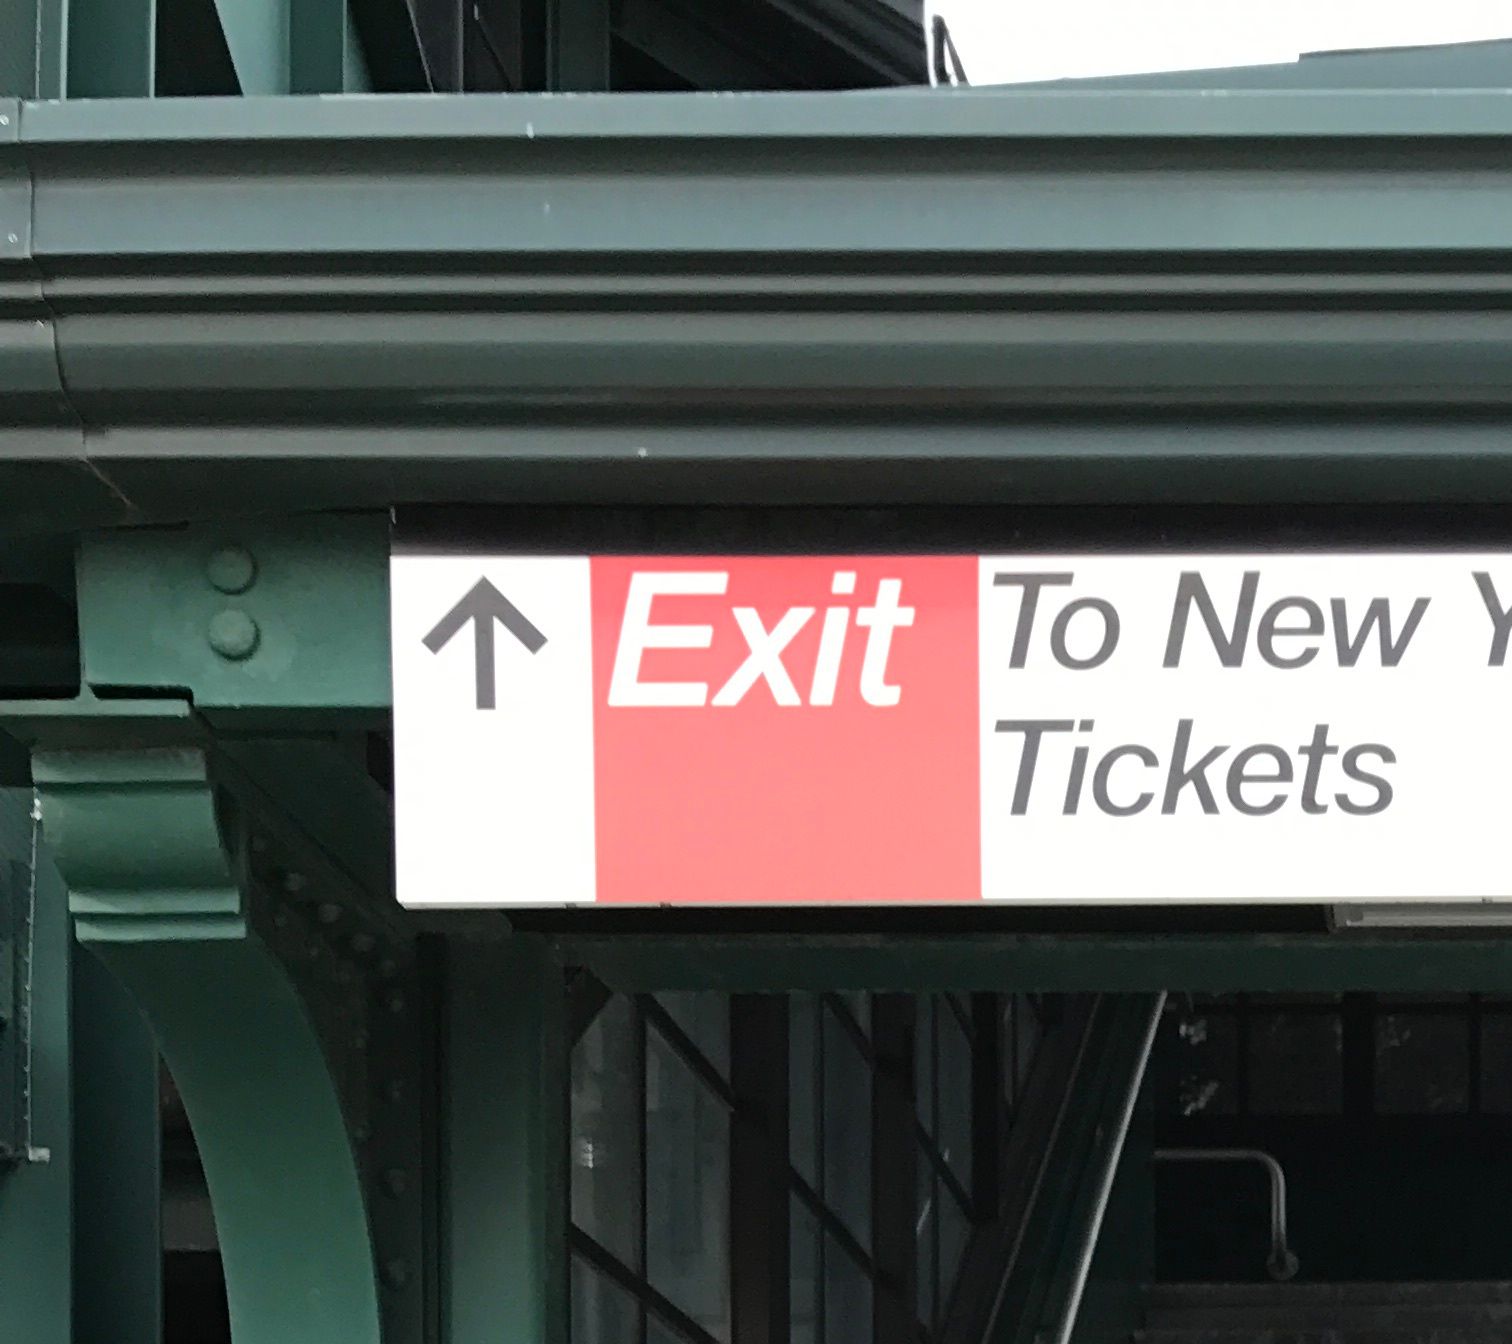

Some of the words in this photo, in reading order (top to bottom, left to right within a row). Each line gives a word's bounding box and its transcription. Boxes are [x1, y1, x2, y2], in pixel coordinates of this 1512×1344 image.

[607, 572, 915, 707] Exit
[993, 572, 1121, 671] To
[1162, 571, 1431, 670] New
[994, 718, 1397, 817] Tickets
